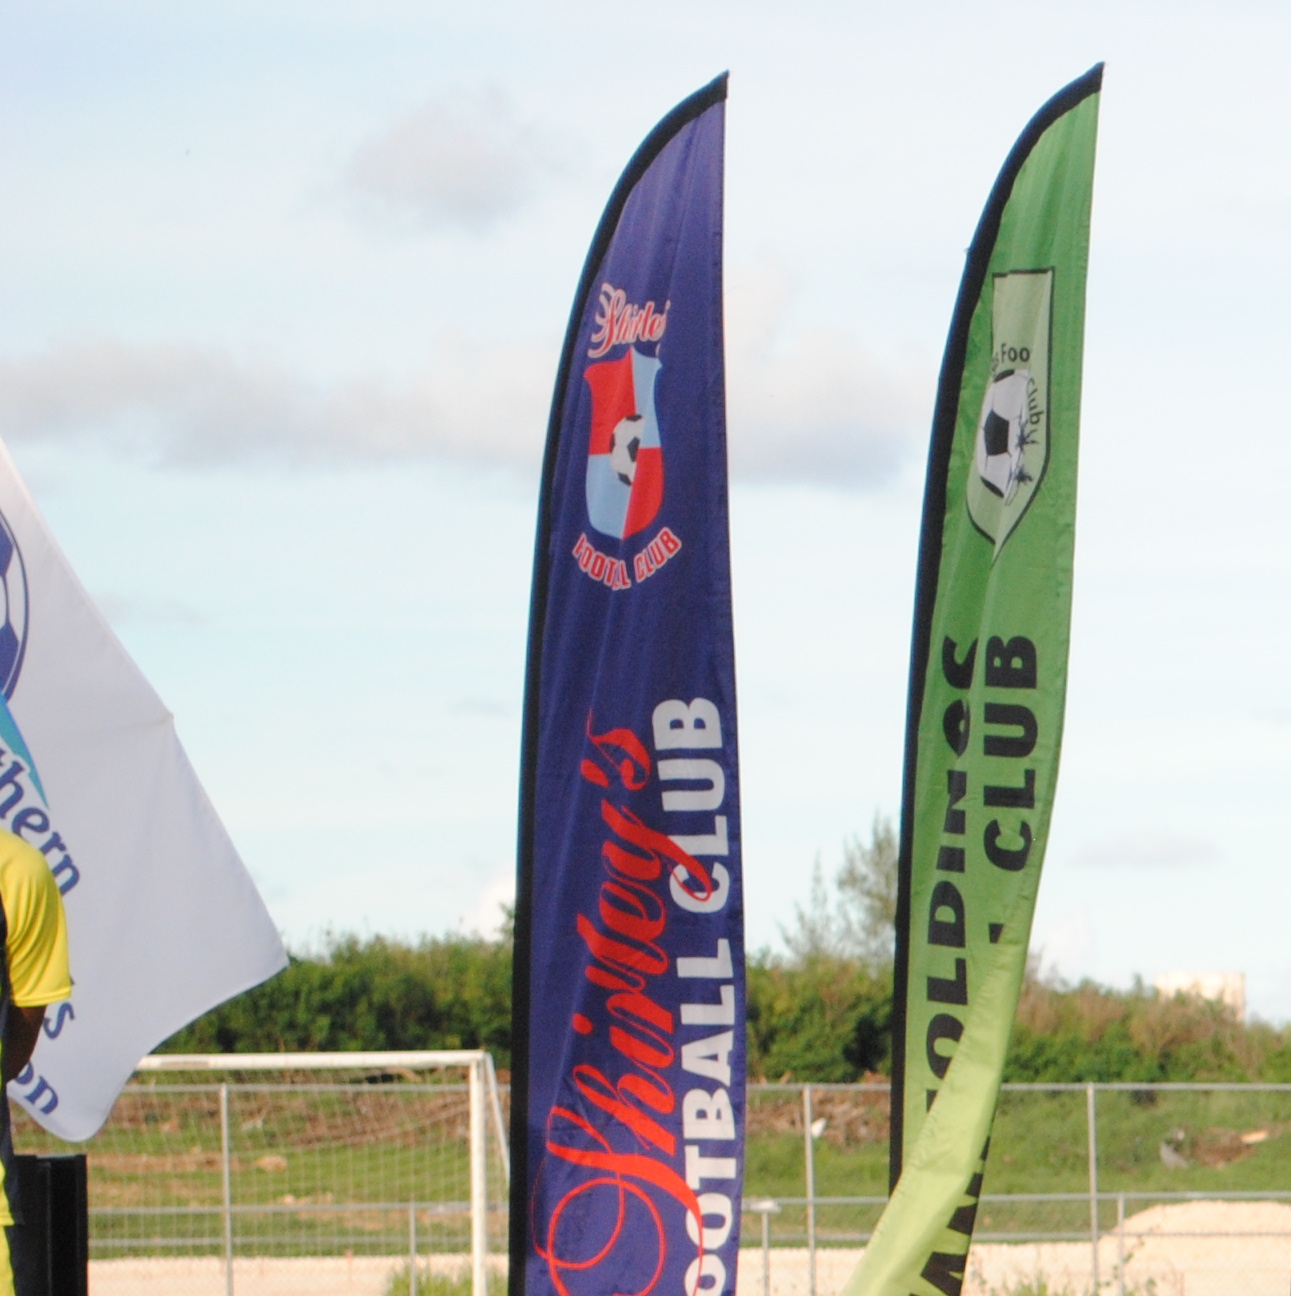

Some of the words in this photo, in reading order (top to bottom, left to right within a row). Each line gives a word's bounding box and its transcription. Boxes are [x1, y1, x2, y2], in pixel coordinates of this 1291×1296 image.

[634, 526, 682, 584] CLUB
[651, 697, 731, 914] CLUB
[983, 635, 1039, 872] CLUB
